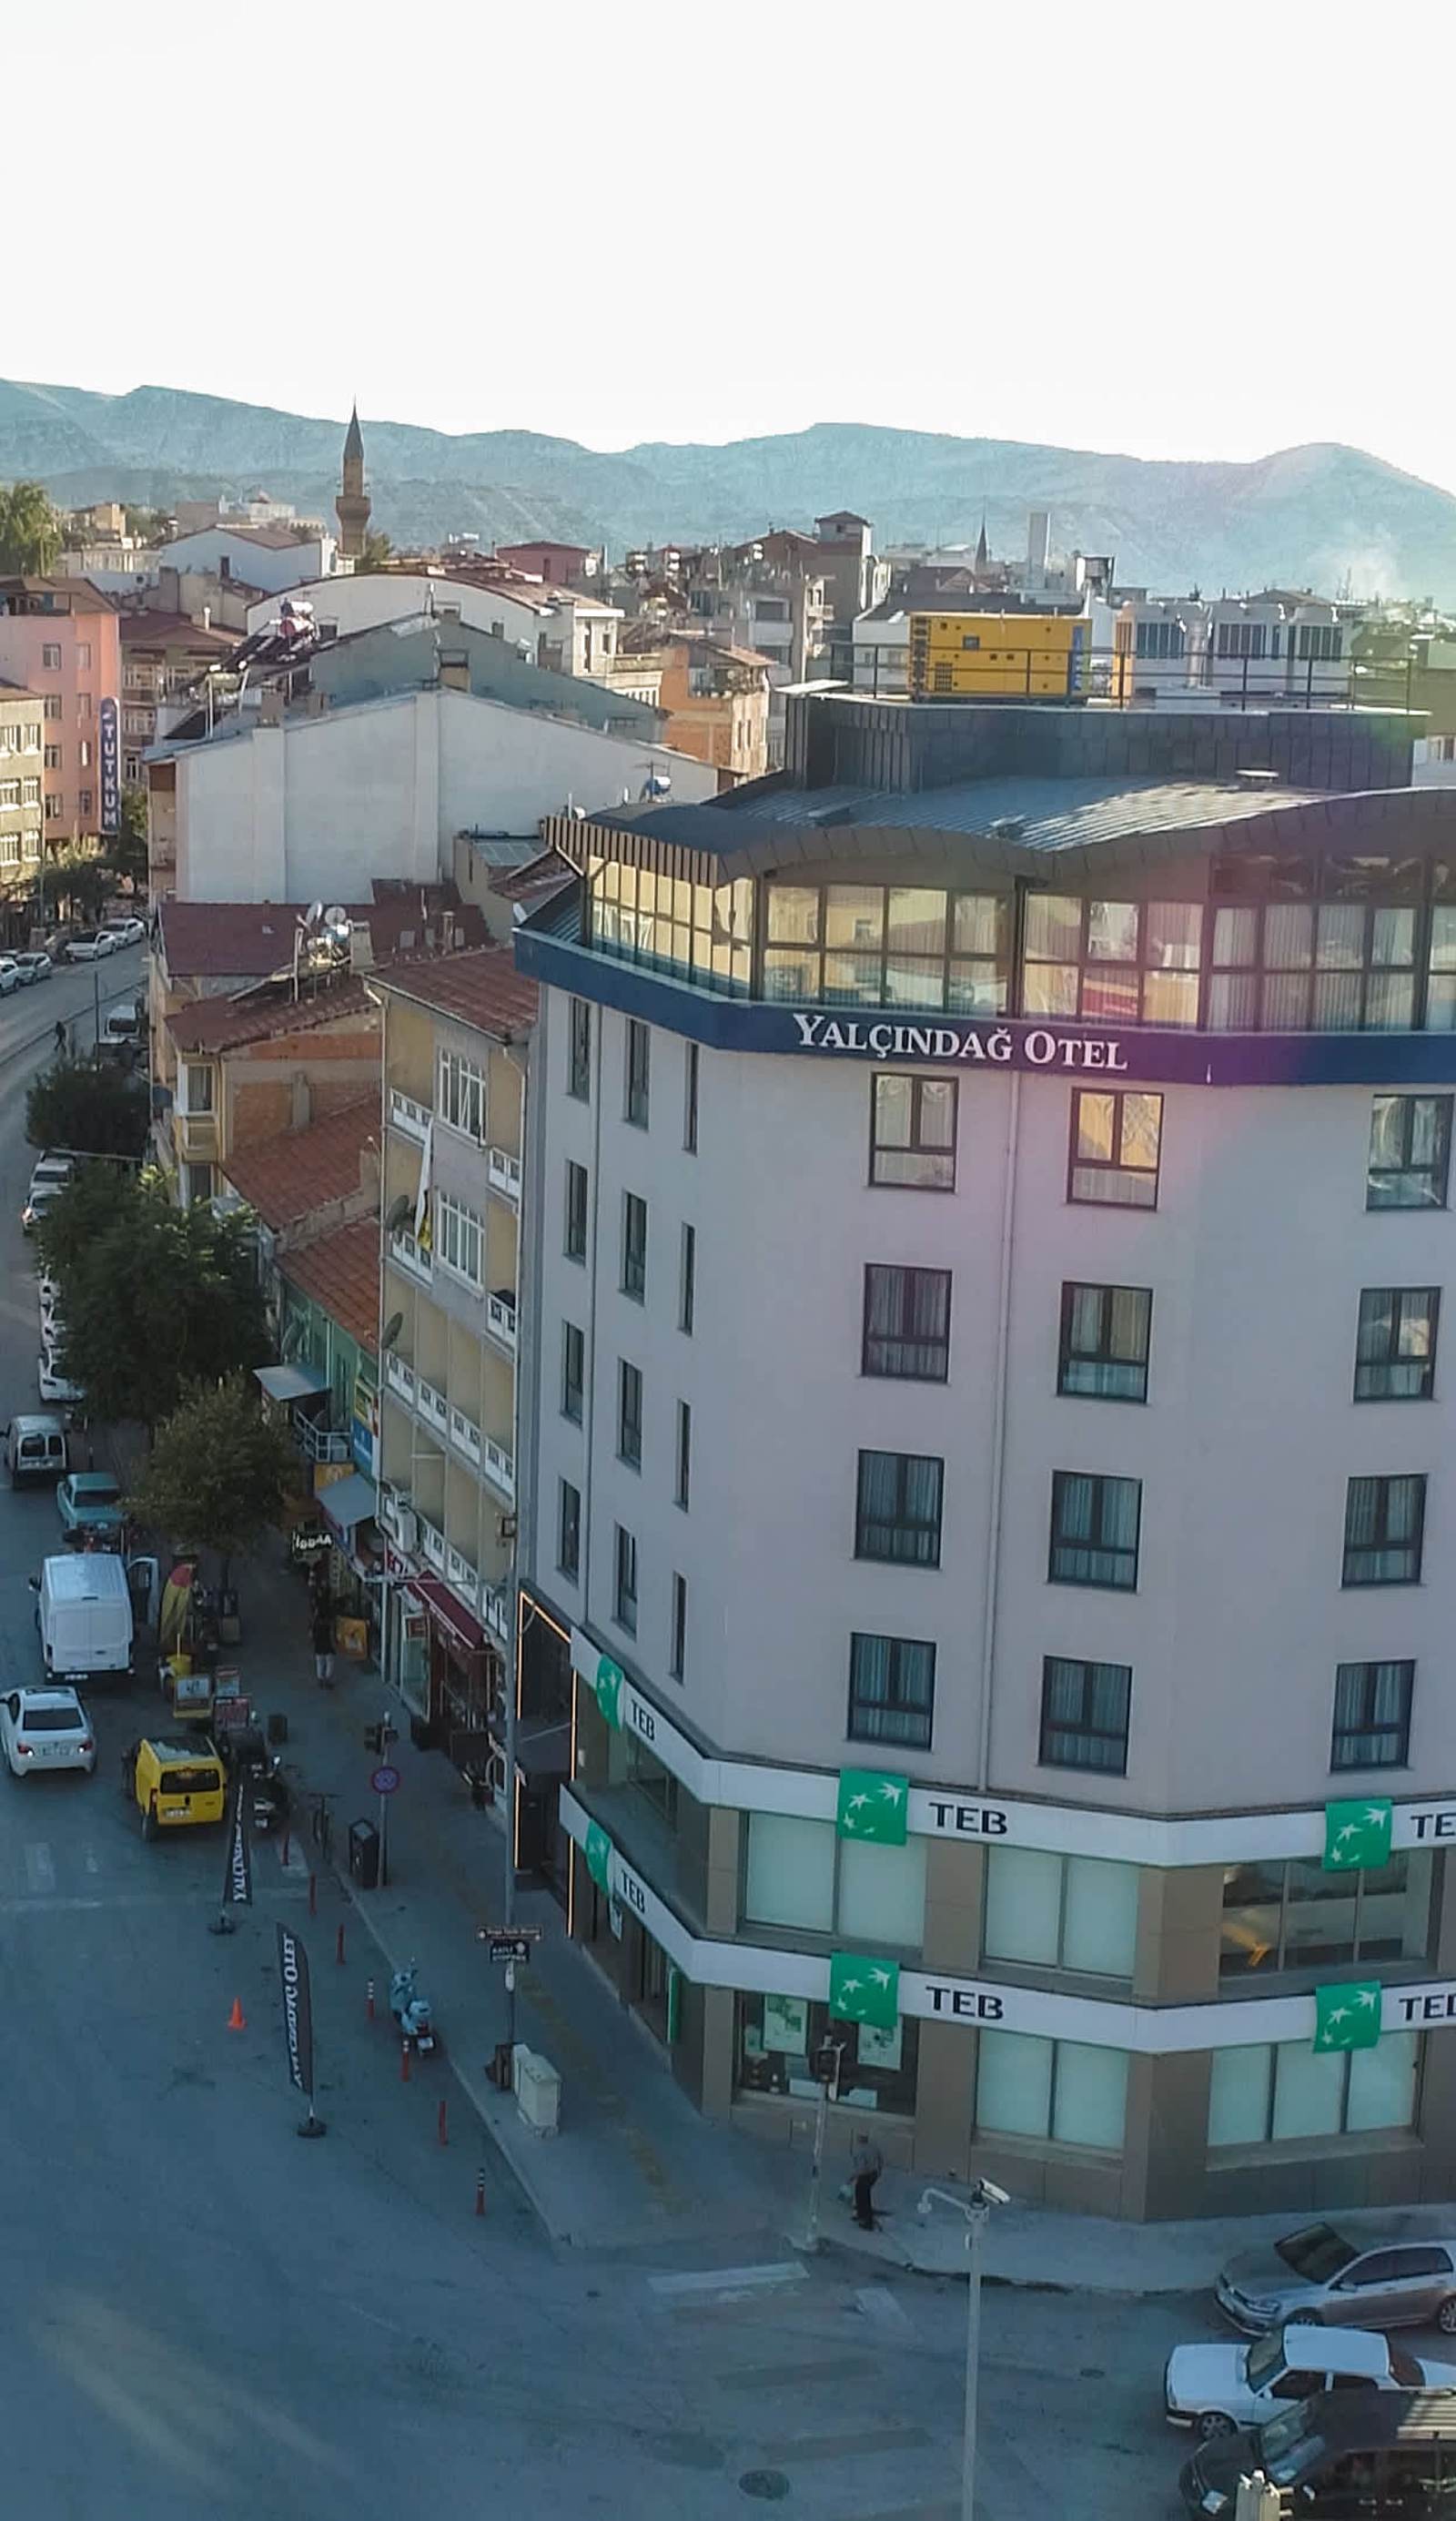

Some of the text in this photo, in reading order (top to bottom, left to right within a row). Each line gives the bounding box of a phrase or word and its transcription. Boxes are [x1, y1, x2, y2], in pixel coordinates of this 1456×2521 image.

[104, 724, 116, 825] TUTKUM
[793, 1013, 1128, 1071] YALÇINDAĞ OTEL
[631, 1699, 655, 1741] TEB
[928, 1802, 1007, 1835] TEB
[621, 1869, 645, 1914] TEB
[925, 1986, 1004, 2020] TEB
